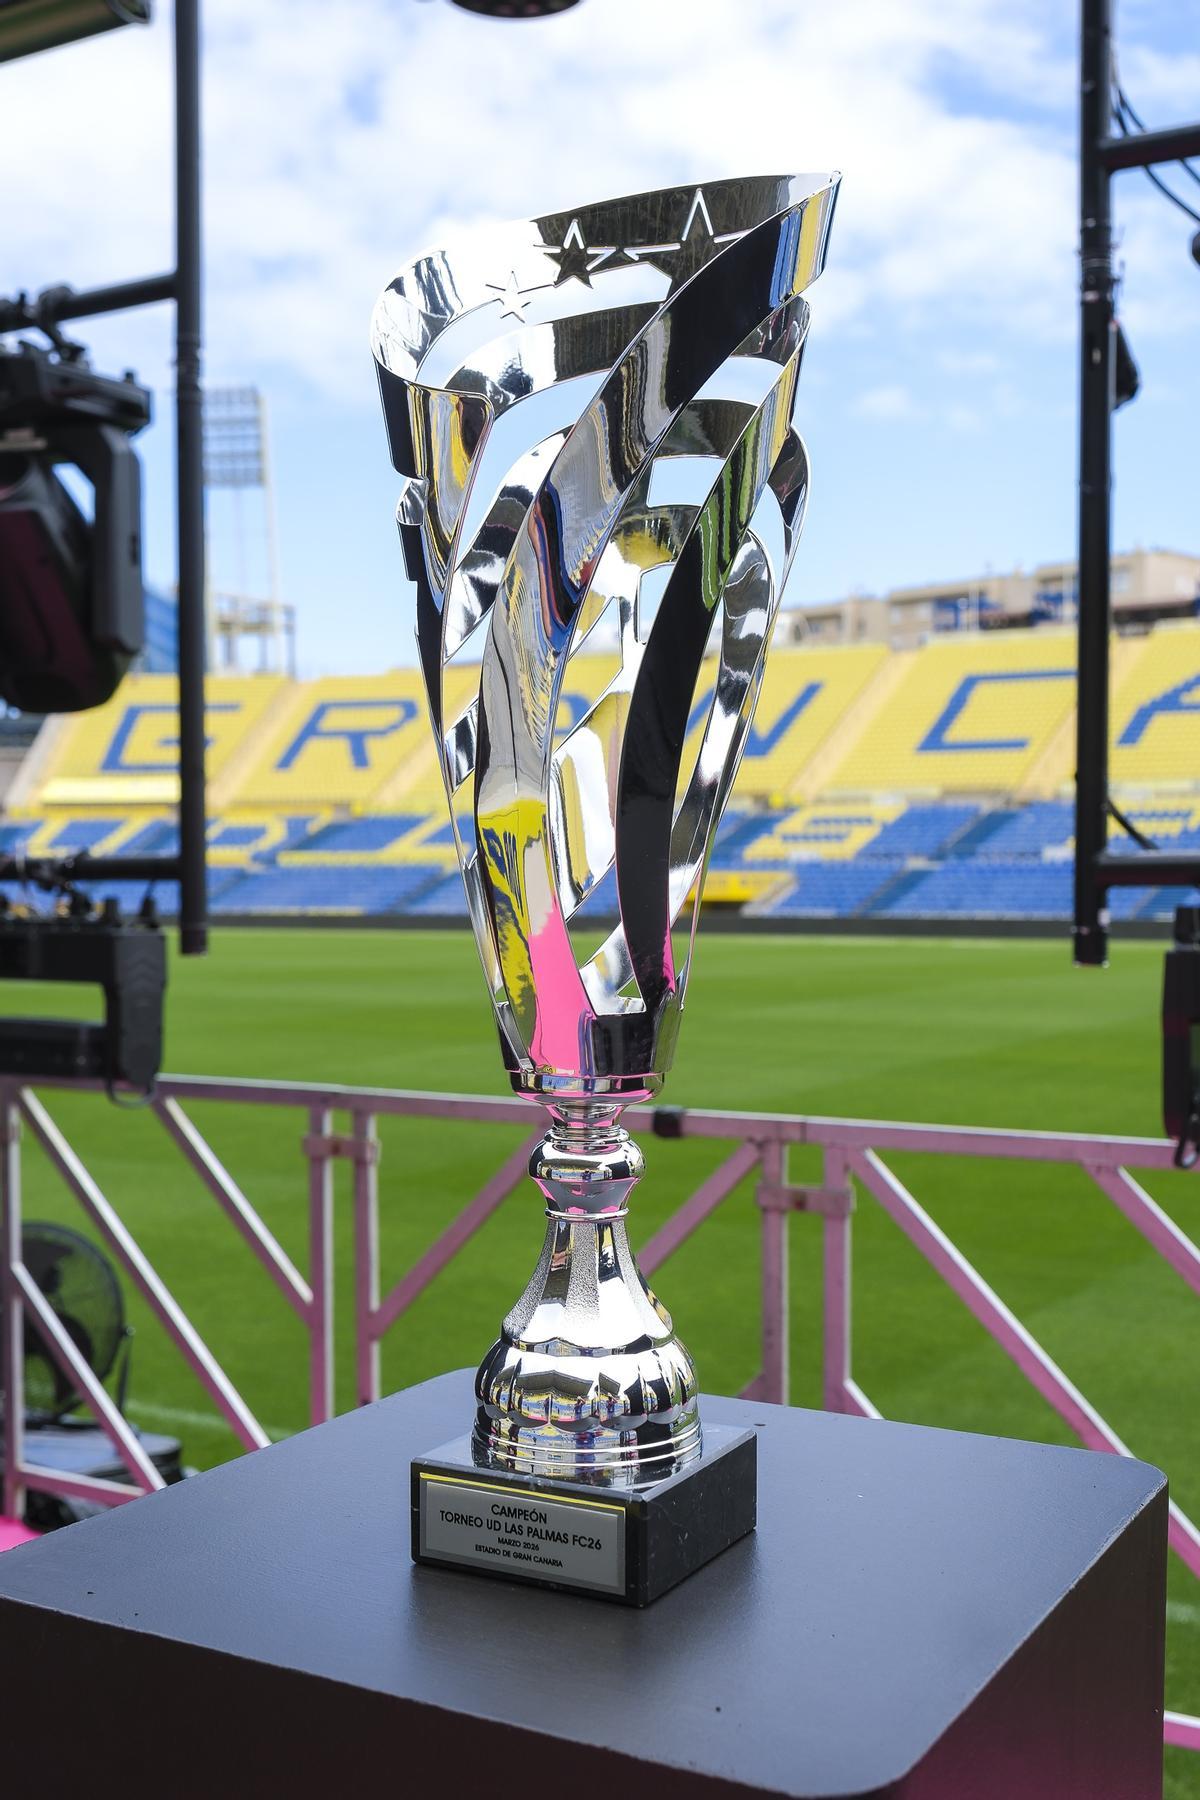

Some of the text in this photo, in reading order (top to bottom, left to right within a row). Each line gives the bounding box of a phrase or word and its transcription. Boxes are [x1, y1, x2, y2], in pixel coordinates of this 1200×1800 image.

[491, 1504, 547, 1524] CAMPEÓN
[440, 1510, 602, 1550] TORNEO UD LAS PALMAS FC26
[497, 1537, 540, 1551] MARZO 2026
[475, 1544, 563, 1568] ESTADIO DE GRAN CANARIA
